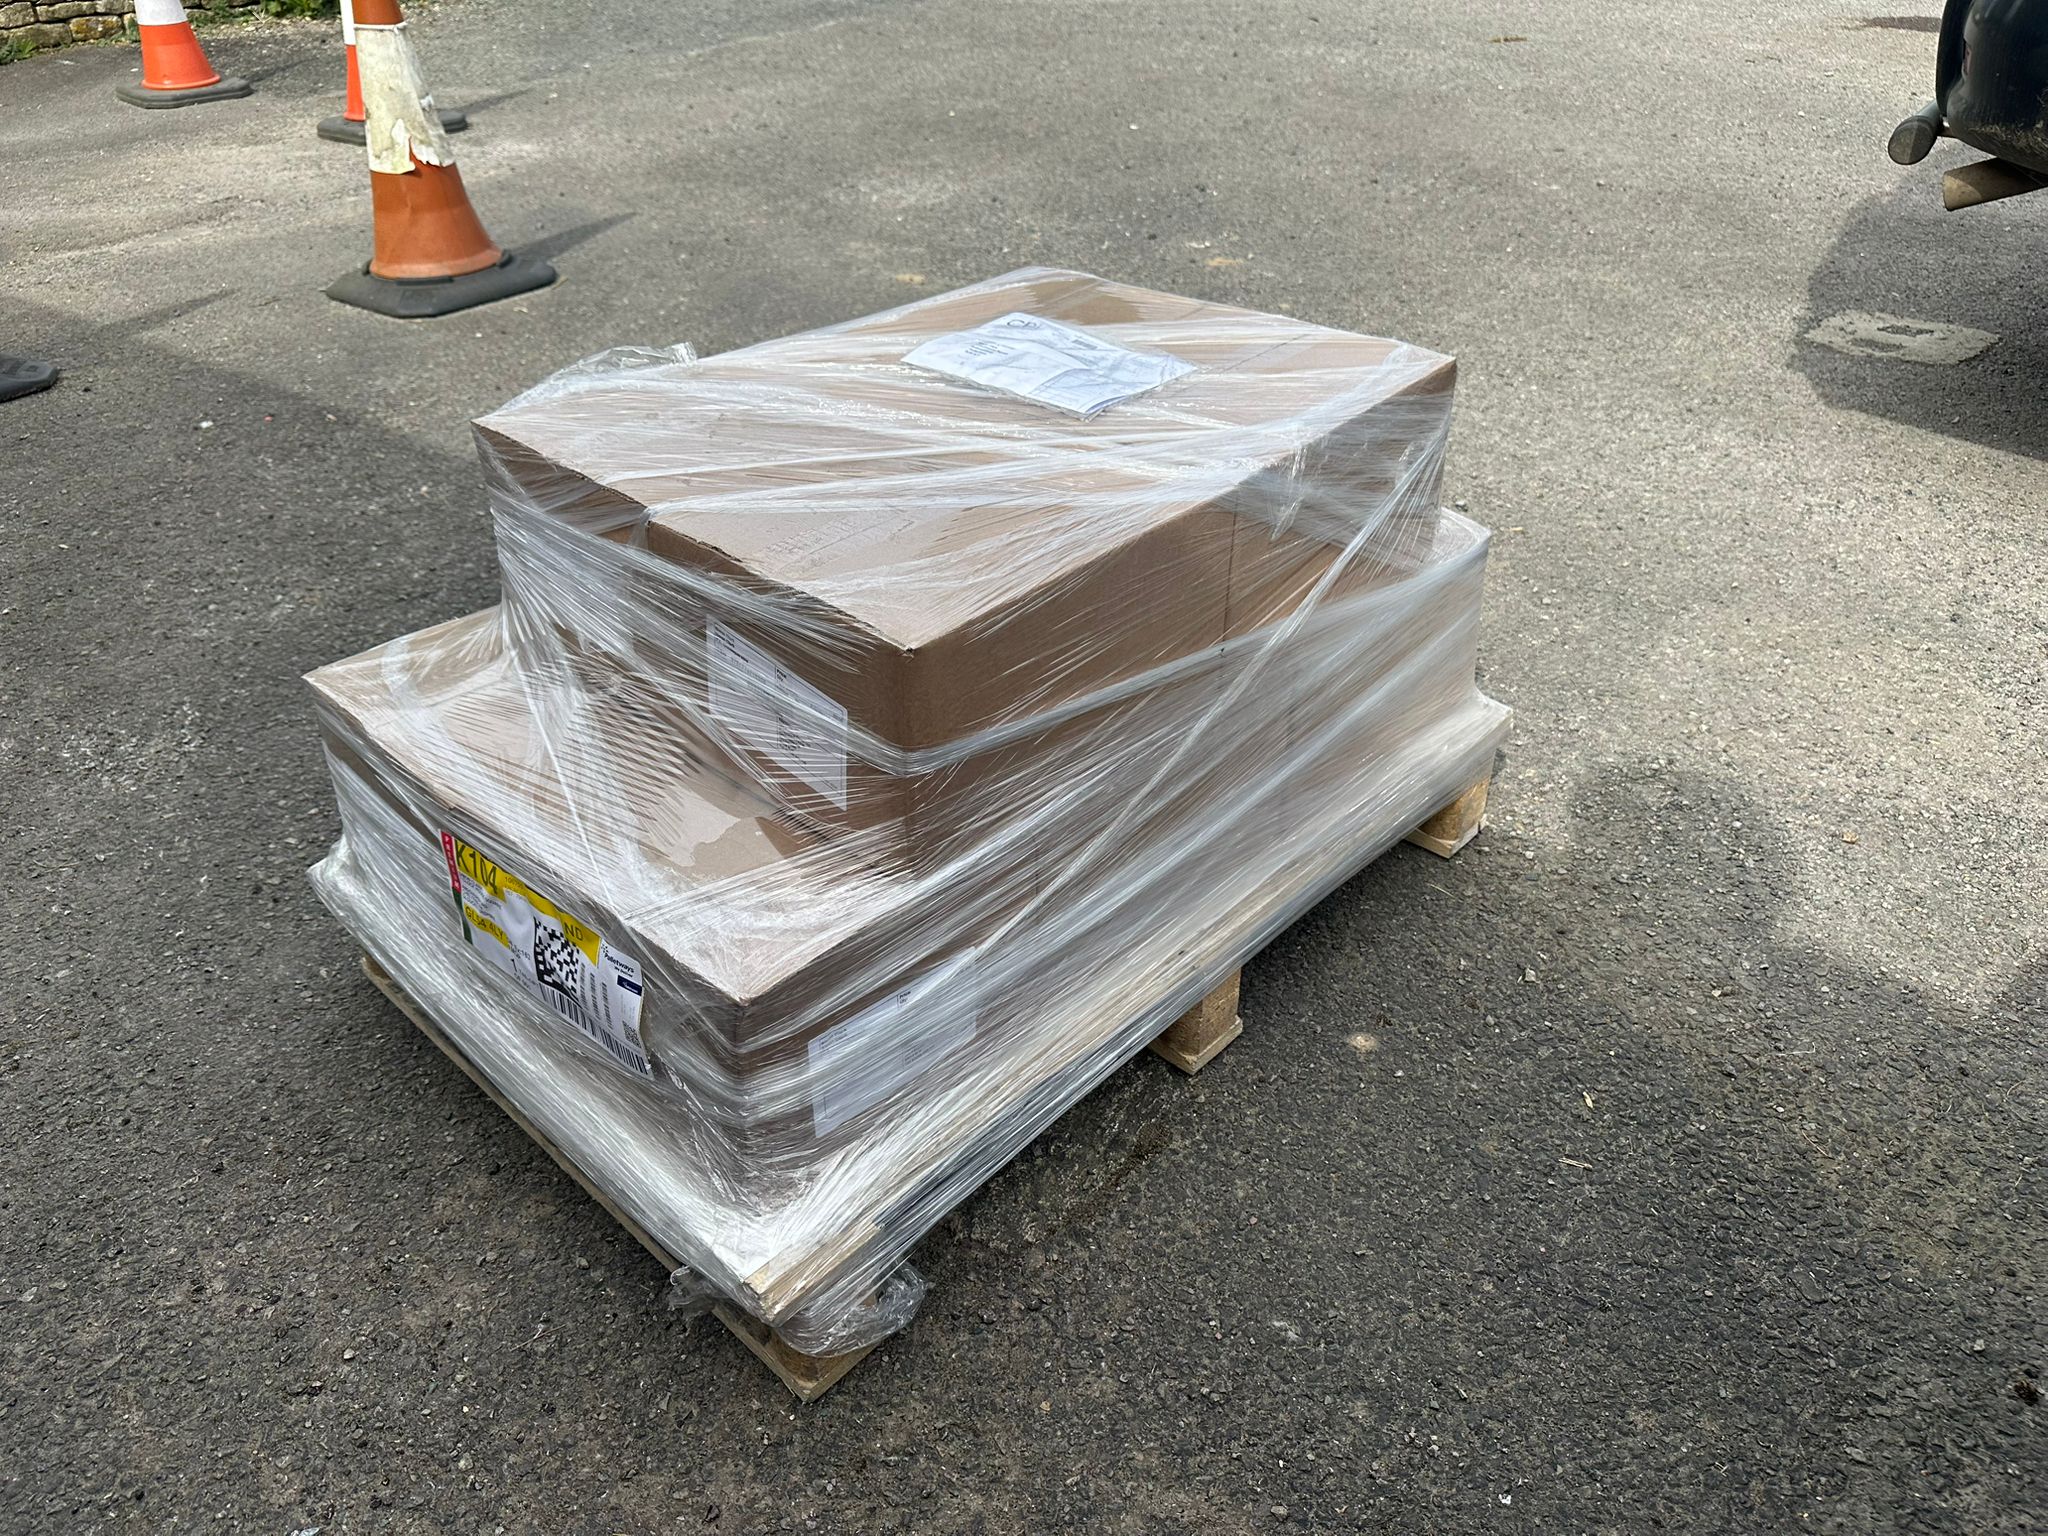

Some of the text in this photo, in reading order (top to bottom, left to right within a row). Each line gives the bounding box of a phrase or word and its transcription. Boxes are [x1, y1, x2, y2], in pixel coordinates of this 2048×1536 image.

[455, 840, 498, 895] K104
[564, 922, 584, 941] ND
[604, 953, 635, 973] Palletways
